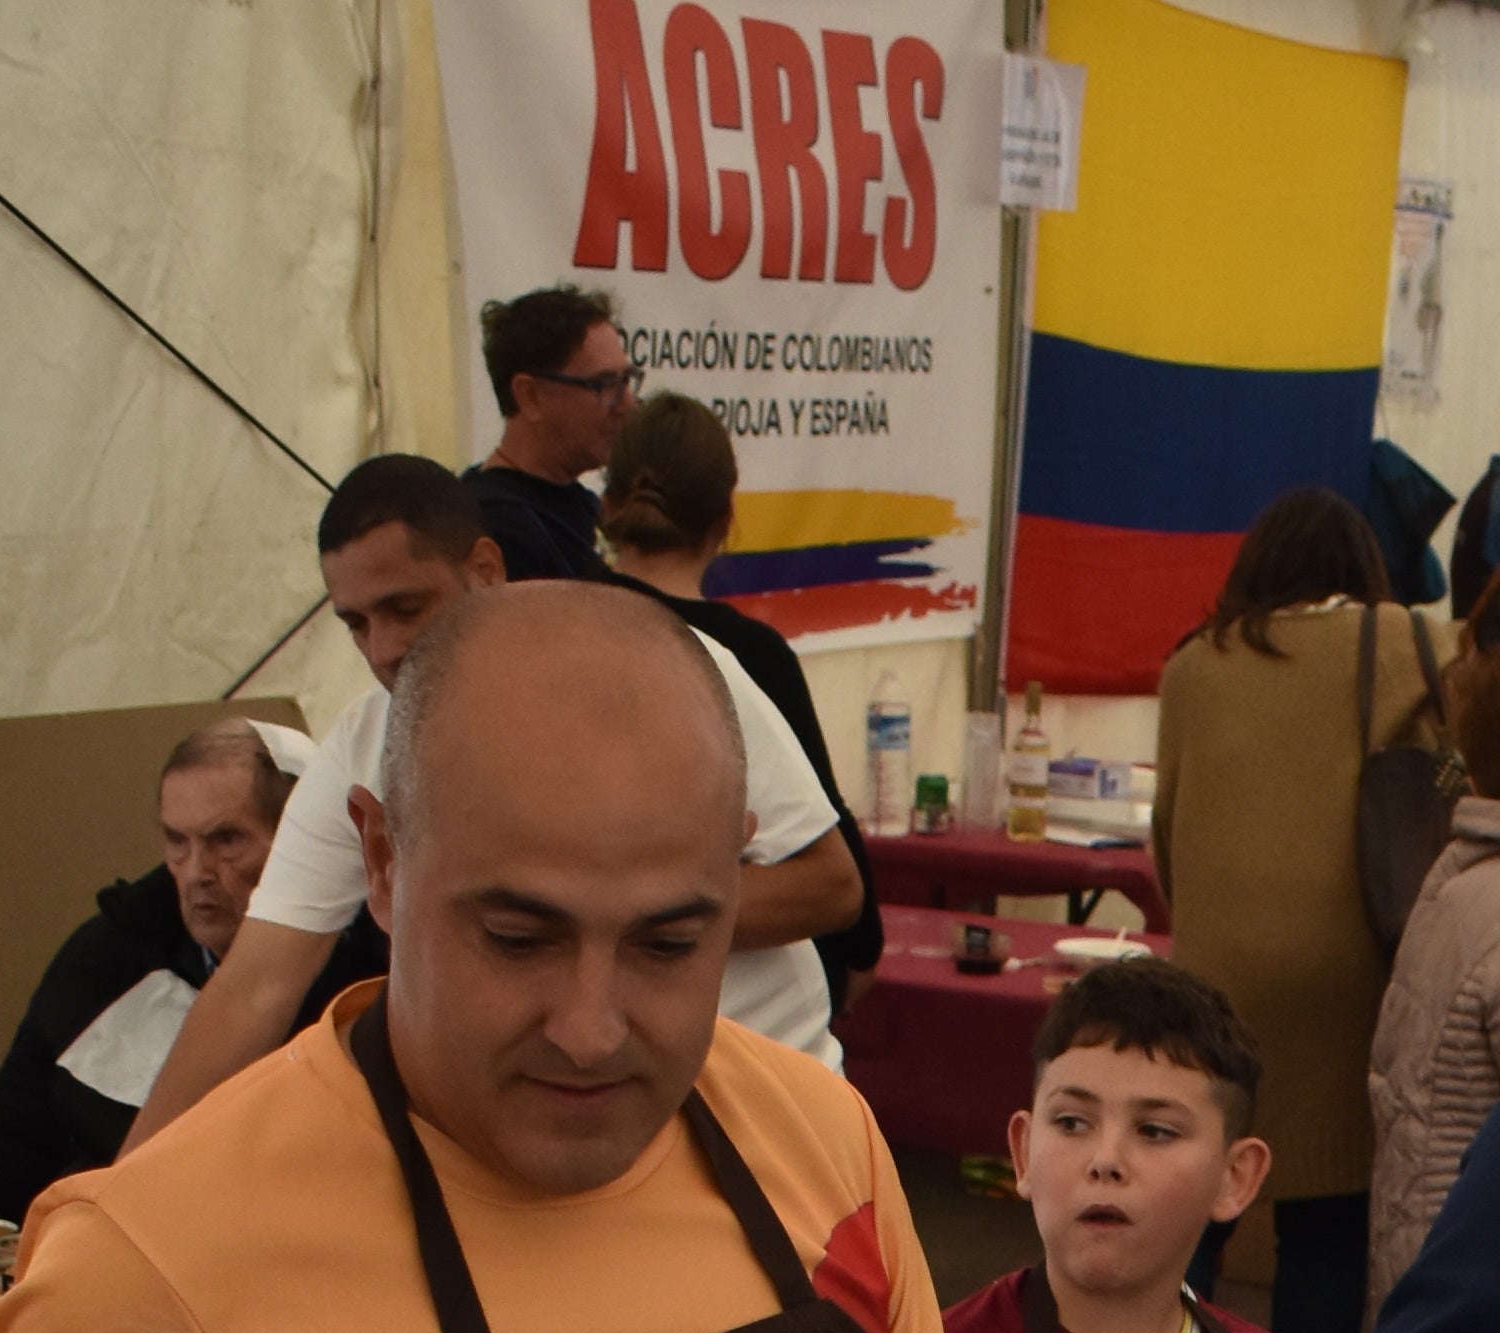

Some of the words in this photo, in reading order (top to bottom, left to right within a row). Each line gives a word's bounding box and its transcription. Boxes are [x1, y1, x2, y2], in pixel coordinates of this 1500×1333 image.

[573, 0, 944, 291] ACRES
[617, 319, 737, 370] OCIACIÓN
[744, 331, 777, 371] DE
[781, 332, 933, 373] COLOMBIANOS
[788, 399, 804, 435] Y
[810, 390, 889, 436] ESPAÑA
